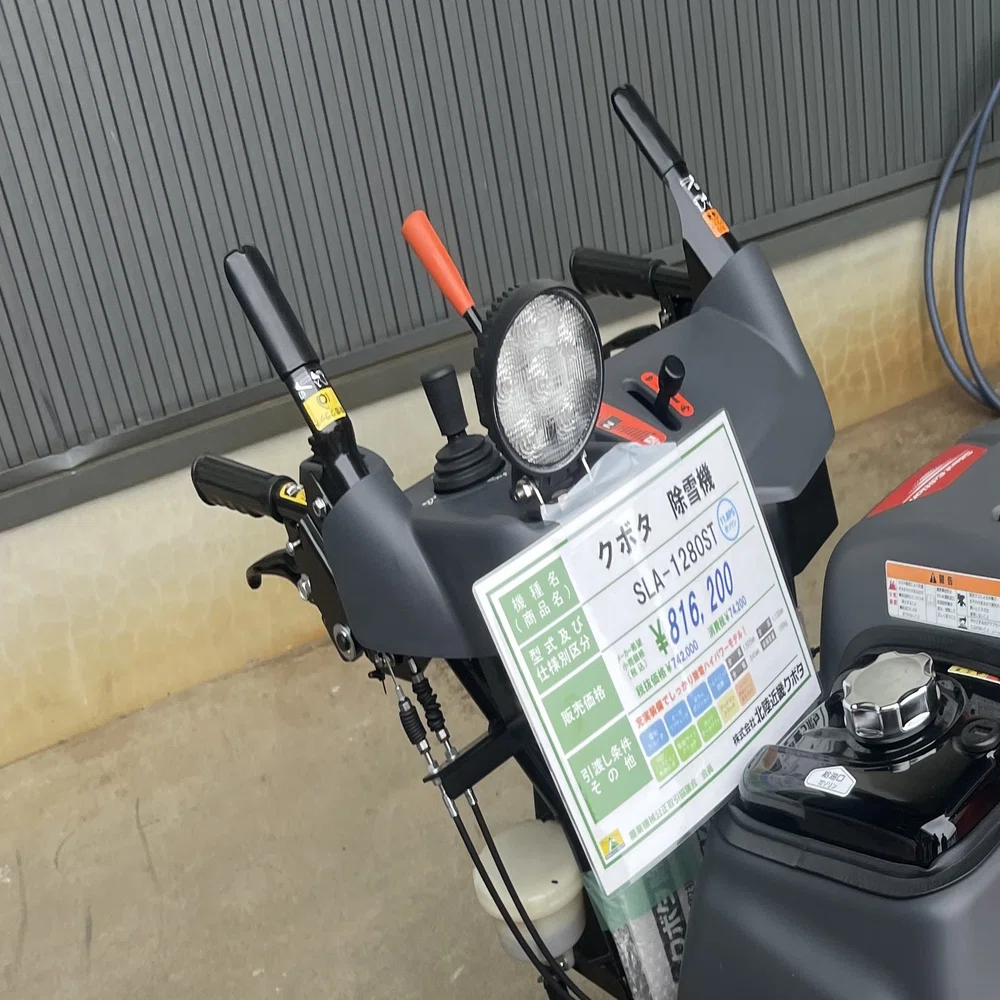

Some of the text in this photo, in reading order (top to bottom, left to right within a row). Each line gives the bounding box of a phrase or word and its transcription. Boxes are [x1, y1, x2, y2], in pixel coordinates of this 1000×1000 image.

[593, 461, 715, 573] クボタ 除雪機
[510, 568, 560, 613] 機種名
[632, 521, 719, 608] SLA-1280ST
[528, 613, 583, 665] 型式及び
[536, 633, 592, 684] 仕様別区分
[560, 681, 606, 729] 販売価格
[732, 715, 756, 746] 株式会社
[752, 661, 805, 723] 北陸近畿クボタ
[580, 733, 633, 785] 引渡し条件
[589, 753, 636, 798] その他
